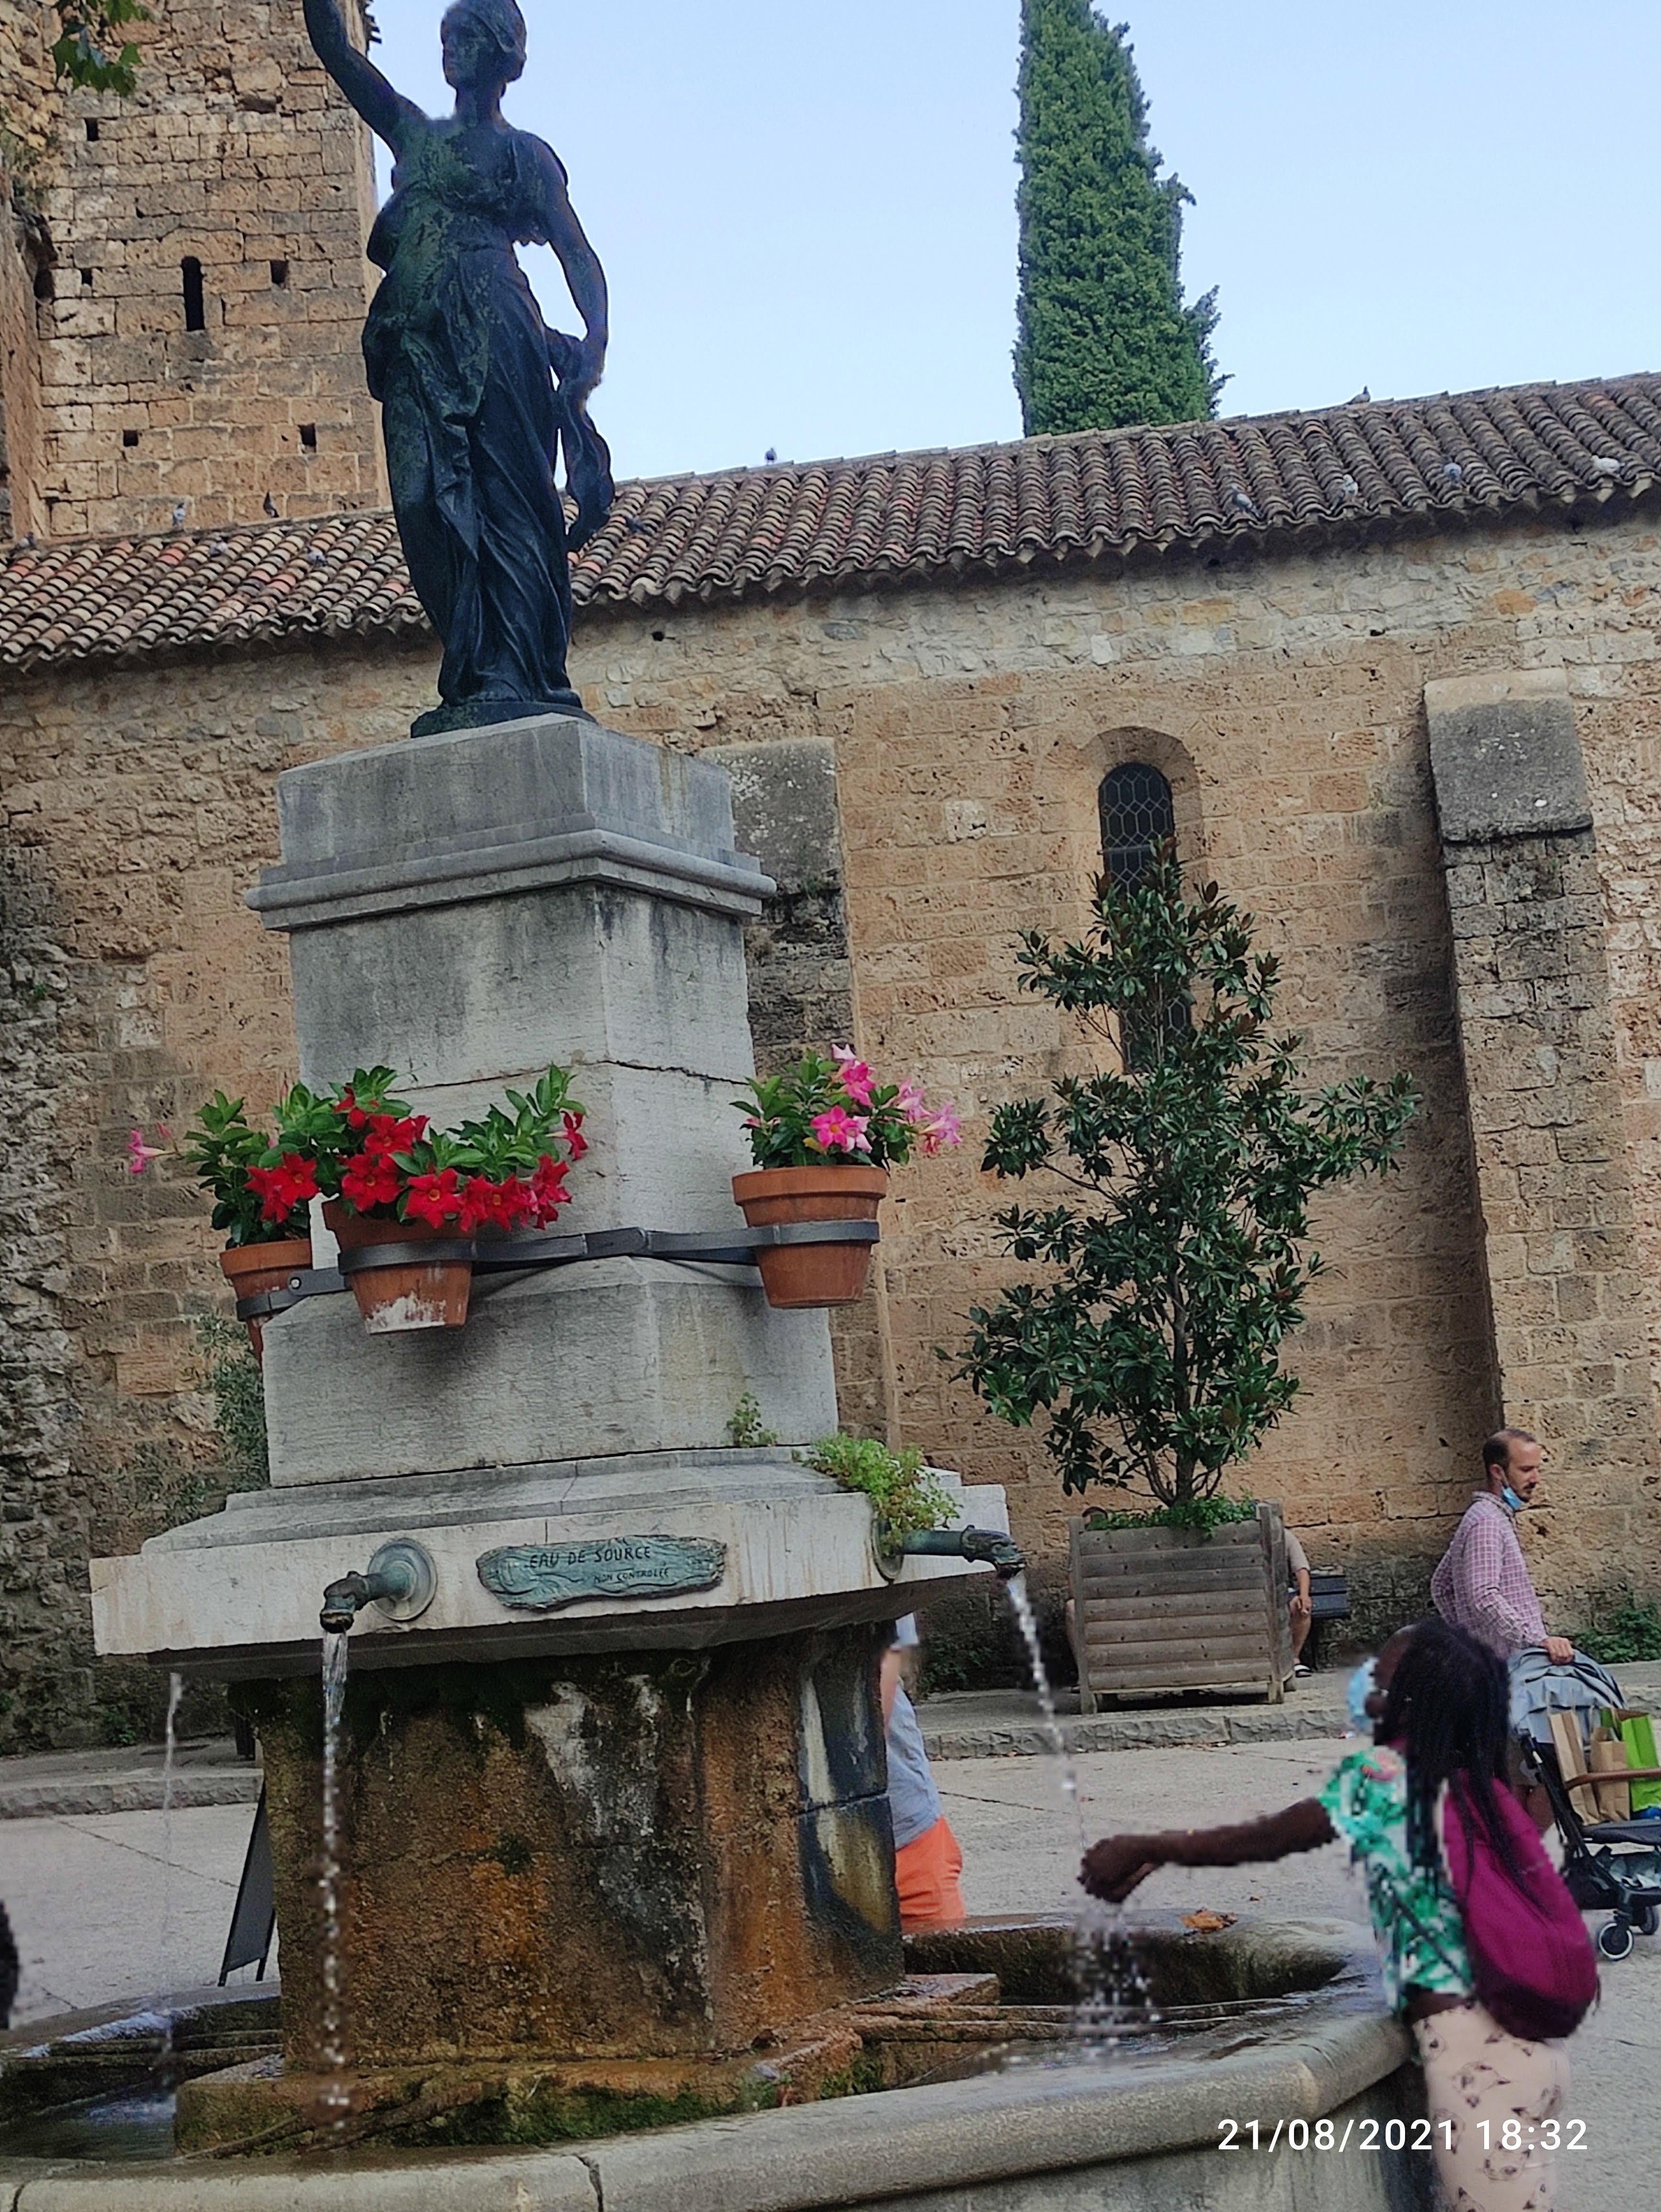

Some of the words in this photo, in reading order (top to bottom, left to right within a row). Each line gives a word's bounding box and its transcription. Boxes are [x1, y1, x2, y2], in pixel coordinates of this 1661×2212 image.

[530, 1553, 559, 1568] EAU
[568, 1550, 586, 1565] DE
[594, 1547, 651, 1562] SOURCE
